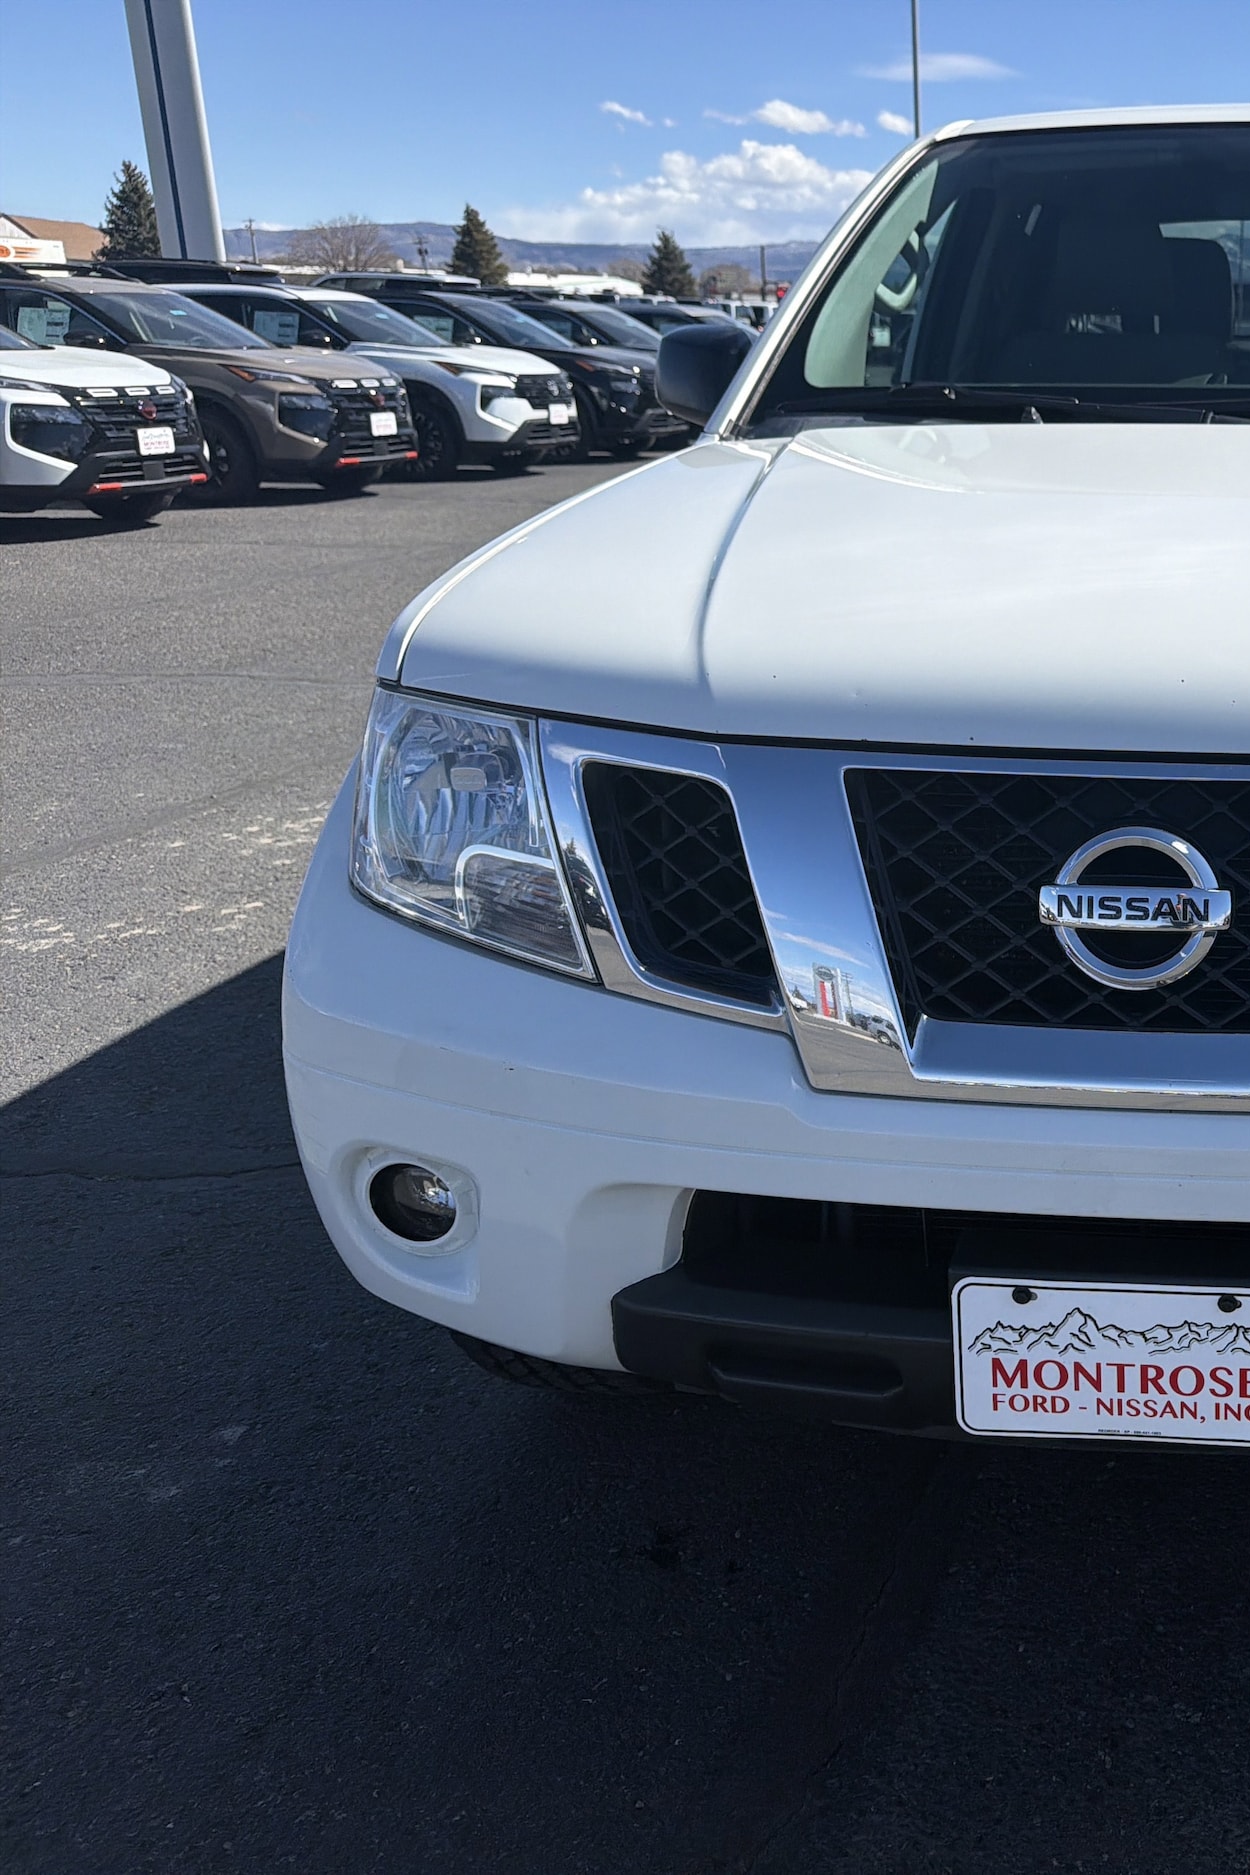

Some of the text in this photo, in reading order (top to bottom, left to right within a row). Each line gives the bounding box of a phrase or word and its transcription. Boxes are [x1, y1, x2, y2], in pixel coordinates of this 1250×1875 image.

[1056, 894, 1210, 922] NISSAN
[992, 1393, 1070, 1414] FORD
[1096, 1398, 1207, 1423] NISSAN,
